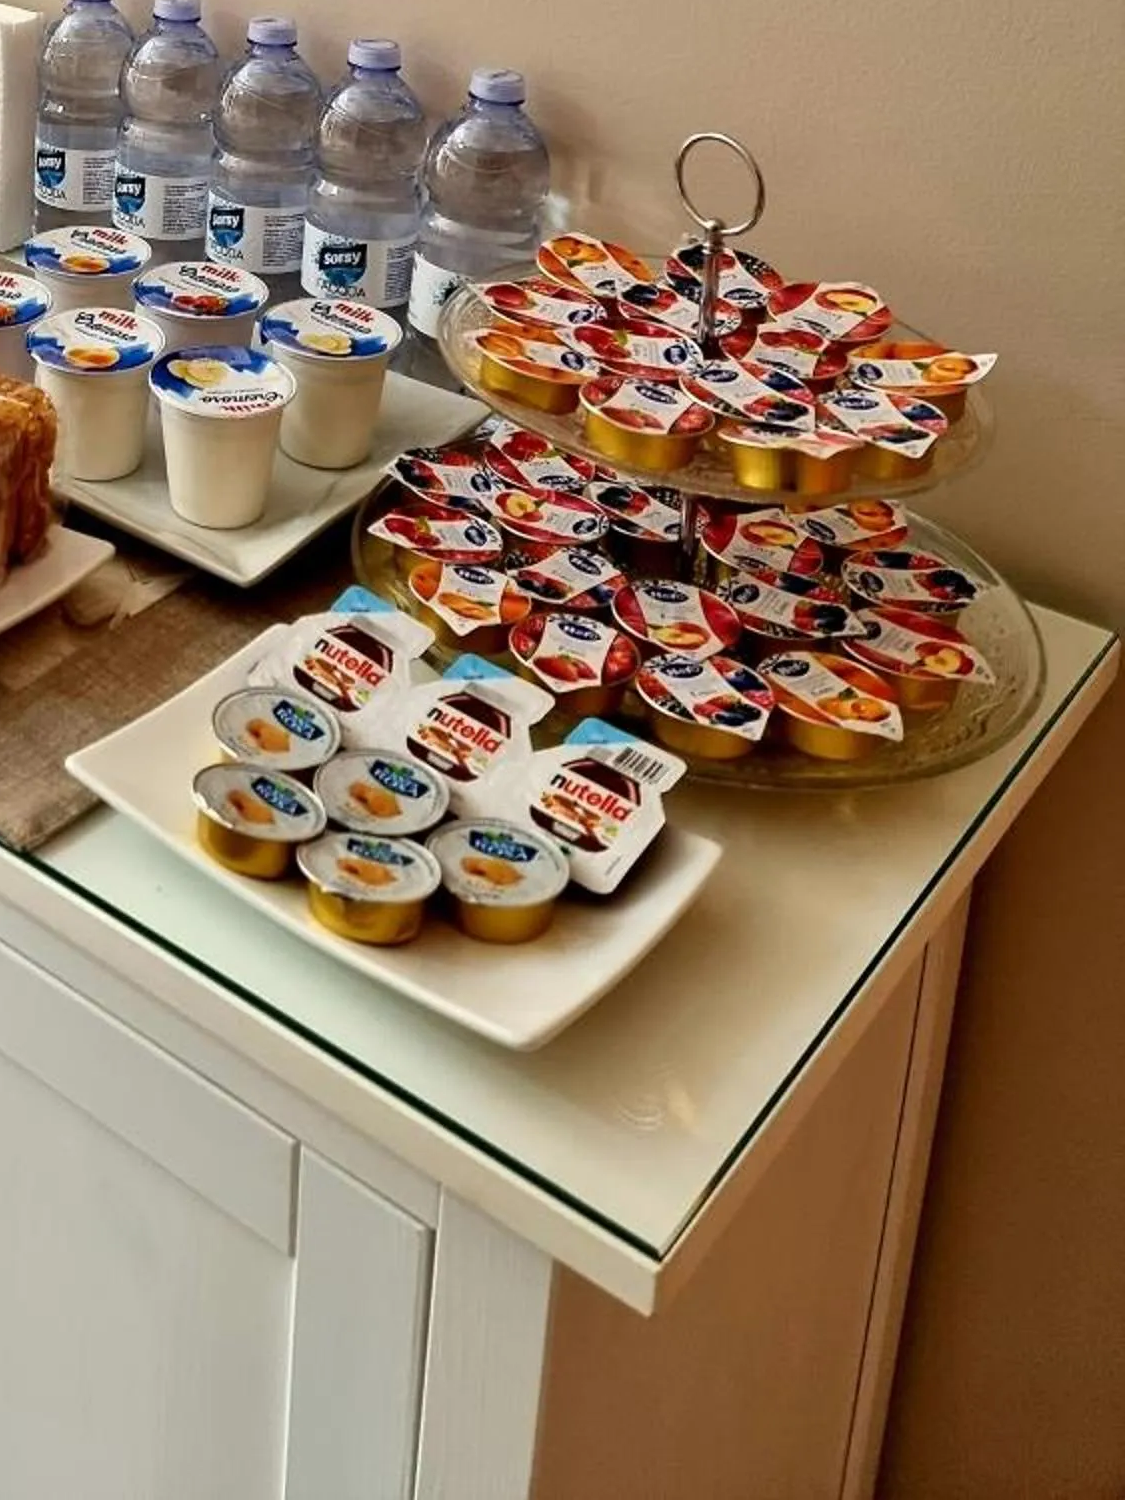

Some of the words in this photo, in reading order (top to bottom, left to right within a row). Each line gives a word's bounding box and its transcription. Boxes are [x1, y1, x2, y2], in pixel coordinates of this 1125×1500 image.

[91, 228, 129, 246] milk
[200, 263, 242, 283] milk
[98, 310, 139, 331] milk
[333, 303, 374, 323] milk
[314, 637, 385, 688] nutella
[426, 707, 501, 753] nutella
[550, 773, 631, 822] nutella
